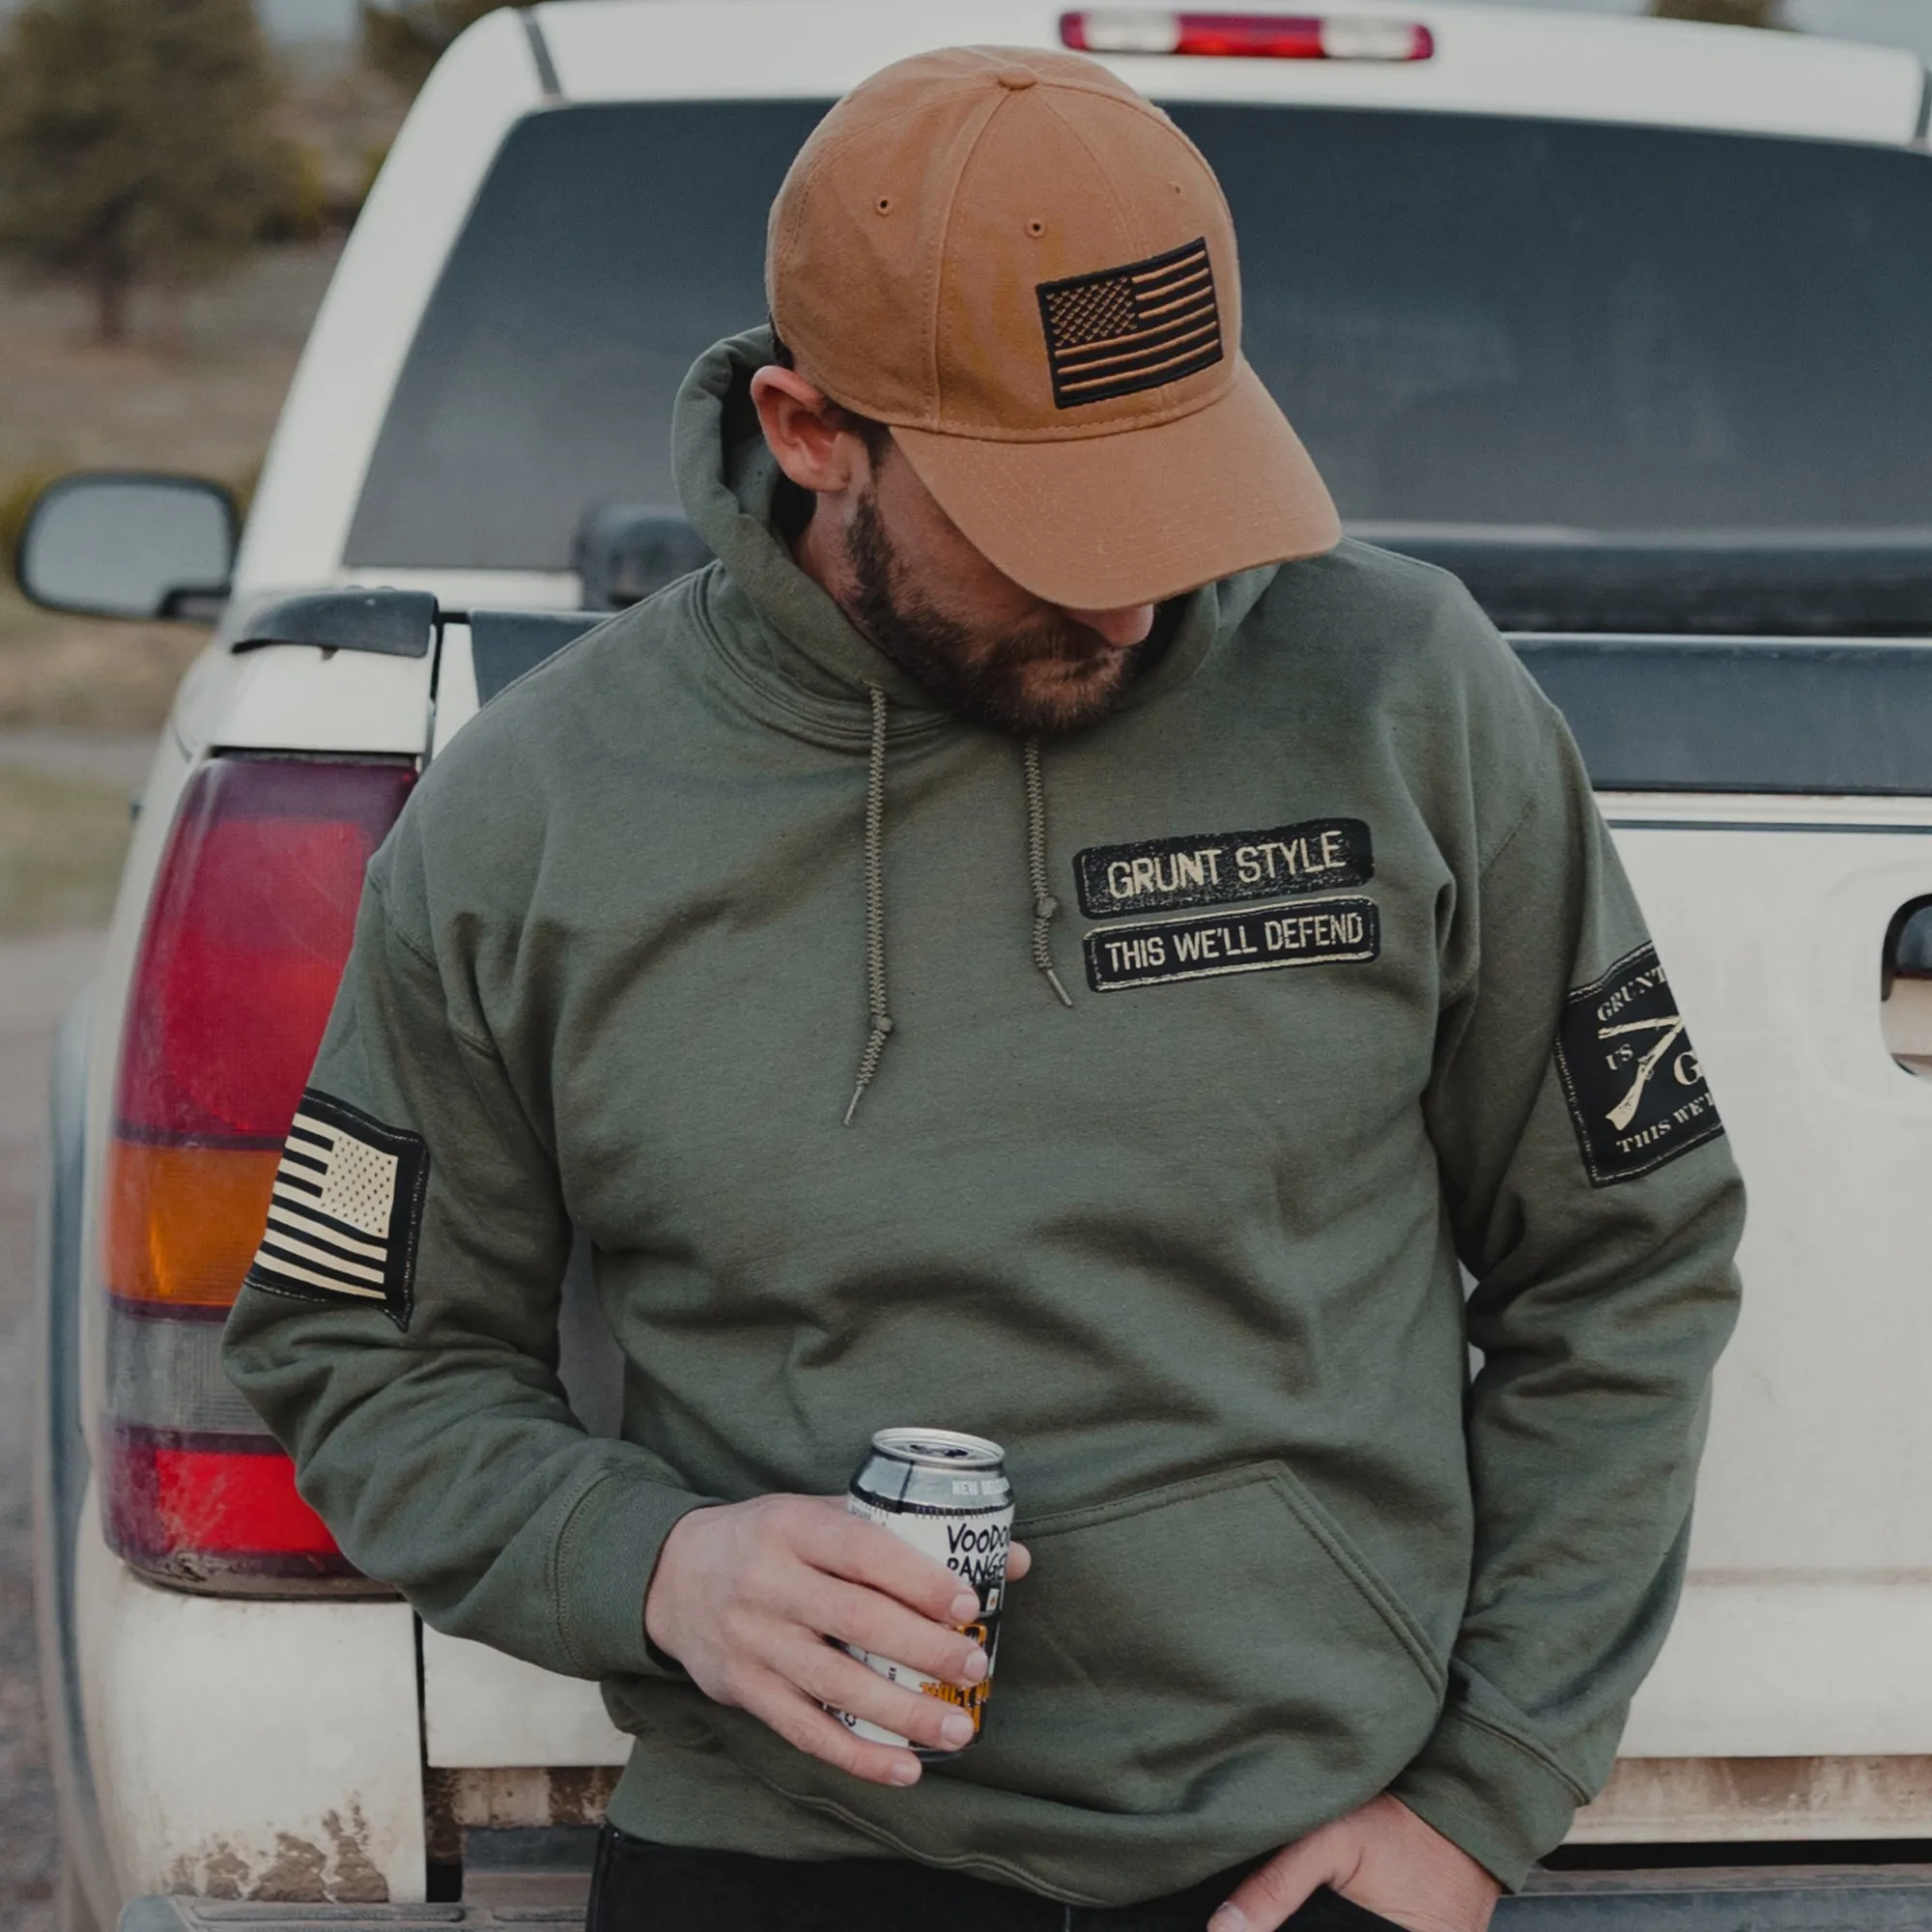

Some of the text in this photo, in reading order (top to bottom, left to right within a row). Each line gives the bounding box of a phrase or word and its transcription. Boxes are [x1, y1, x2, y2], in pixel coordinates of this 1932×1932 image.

[1107, 830, 1347, 899] GRUNT STYLE
[1105, 913, 1364, 973] THIS WE'LL DEFEND
[1616, 1119, 1672, 1152] THIS
